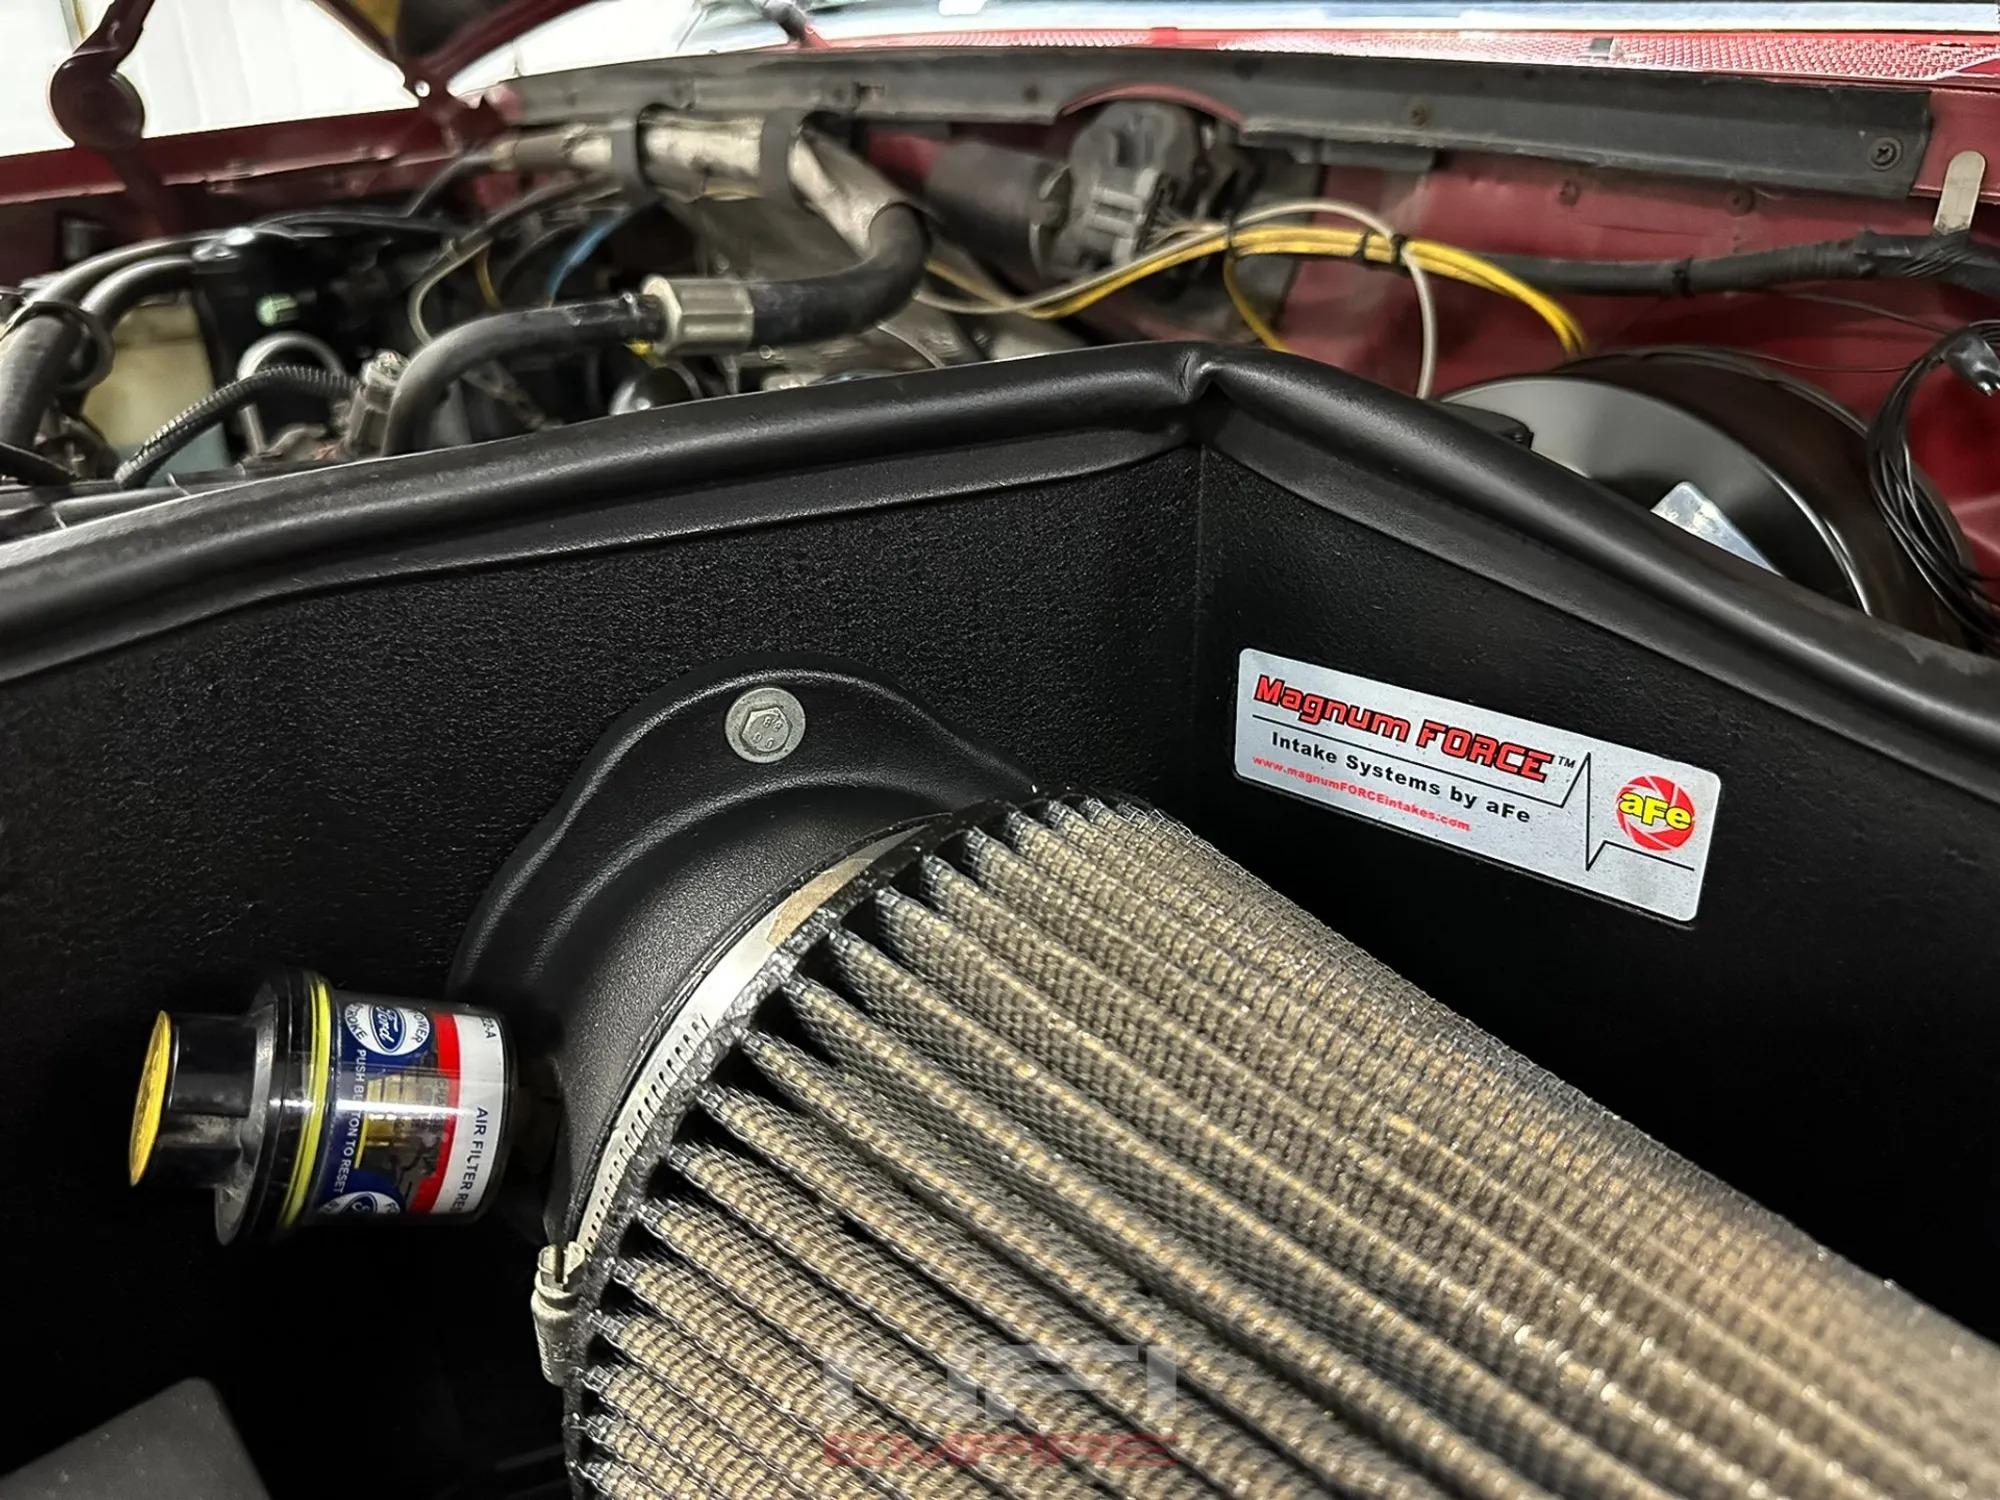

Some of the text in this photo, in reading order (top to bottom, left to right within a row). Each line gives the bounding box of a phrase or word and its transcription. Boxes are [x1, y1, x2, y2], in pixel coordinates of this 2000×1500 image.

[1254, 675, 1411, 743] Magnum
[1416, 719, 1555, 783] FORCE
[1252, 755, 1472, 832] www.magnumFORCEintakes.com
[1272, 732, 1531, 823] Intake Systems by aFe
[1619, 792, 1692, 831] aFe
[354, 1049, 367, 1082] PUSH
[474, 1107, 489, 1136] AIR
[343, 1140, 357, 1157] TO
[460, 1140, 484, 1191] FILTER
[333, 1159, 351, 1194] RESET
